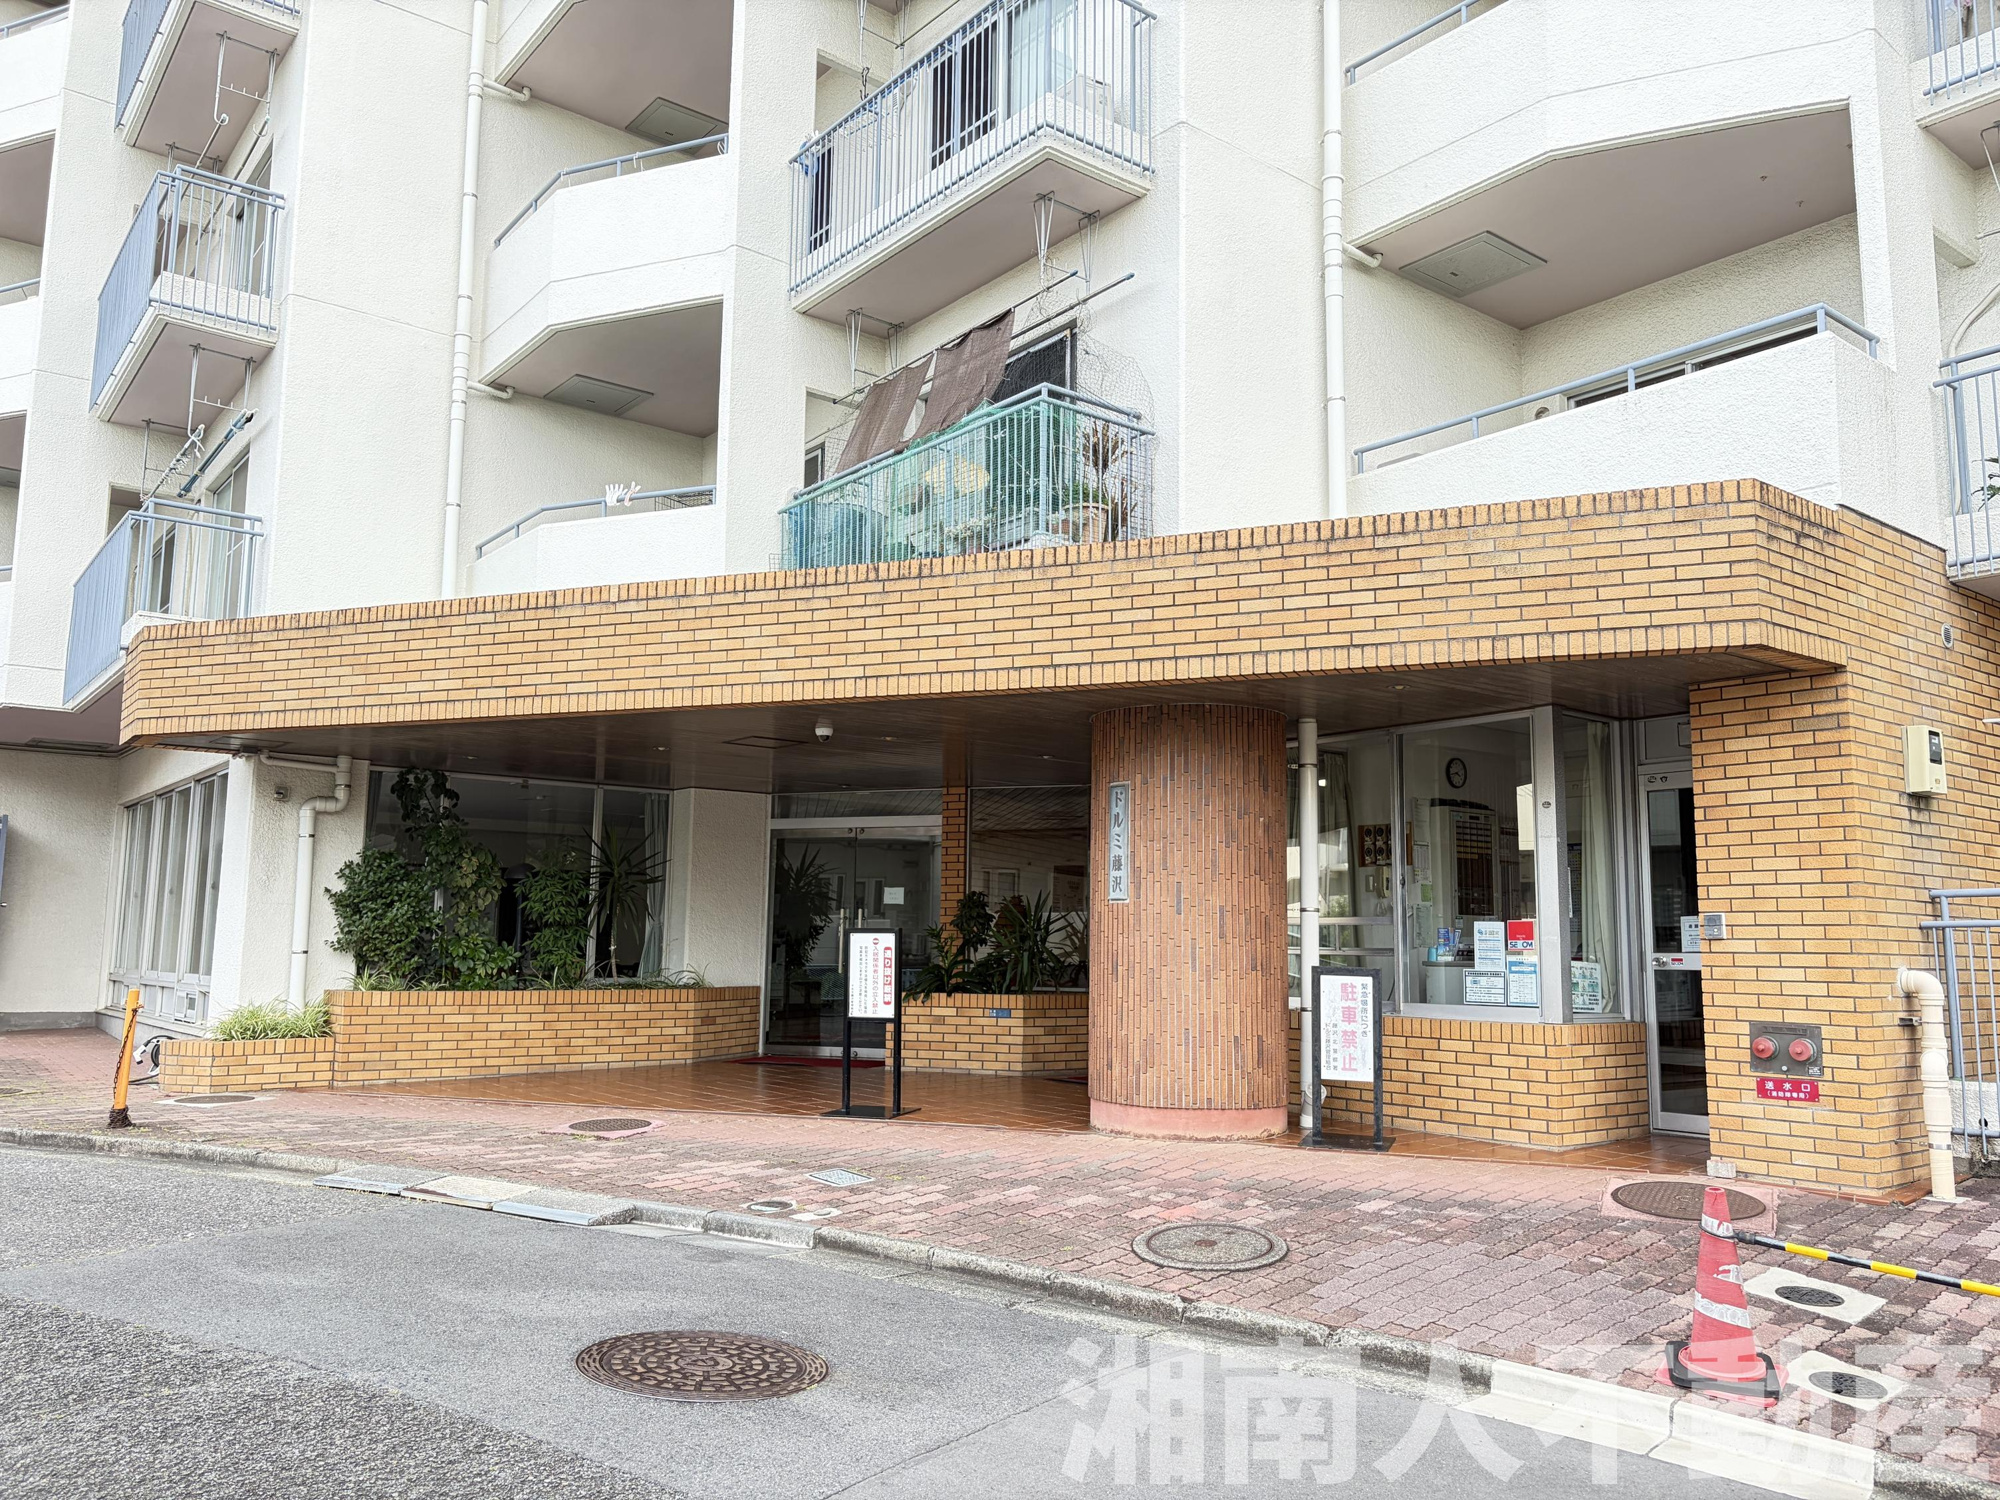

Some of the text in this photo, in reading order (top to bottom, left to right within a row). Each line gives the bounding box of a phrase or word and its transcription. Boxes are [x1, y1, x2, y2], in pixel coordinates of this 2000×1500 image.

[1111, 790, 1124, 893] ドルミ藤沢
[1509, 941, 1533, 949] SECOM
[1340, 982, 1358, 1072] 駐車禁止
[1764, 1081, 1811, 1092] 送水口
